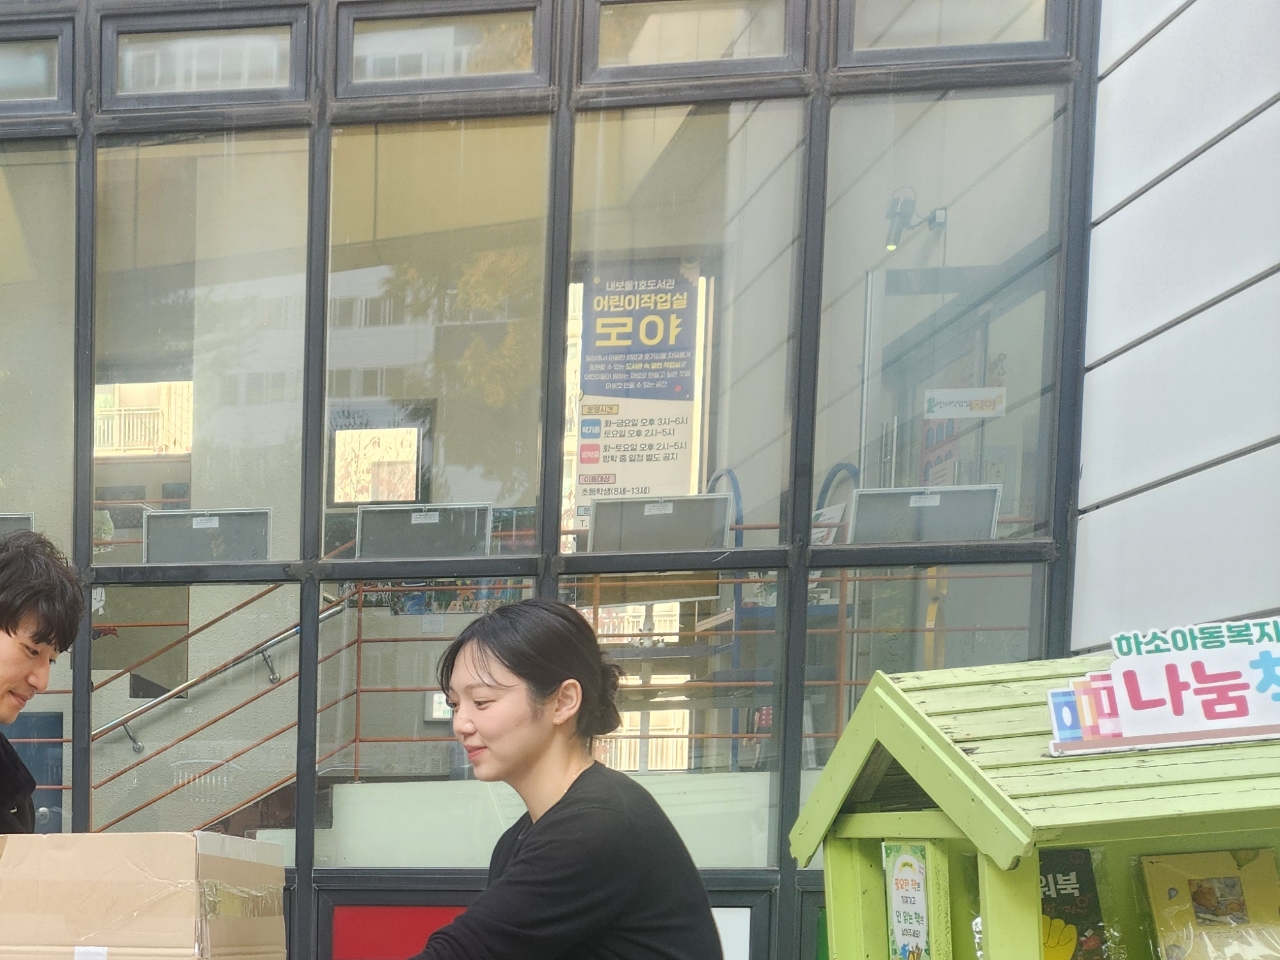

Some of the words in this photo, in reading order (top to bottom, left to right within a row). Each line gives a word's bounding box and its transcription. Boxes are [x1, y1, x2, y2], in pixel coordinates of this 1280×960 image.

[606, 279, 676, 291] 내보물1호도서관
[593, 292, 688, 312] 어린이작업실
[595, 314, 683, 347] 모야
[640, 418, 655, 427] 오후
[603, 429, 626, 438] 토요일
[628, 429, 643, 438] 오후
[639, 443, 655, 451] 오후
[602, 454, 617, 463] 방학
[628, 454, 644, 463] 일정
[1114, 620, 1280, 657] 하소아동복지
